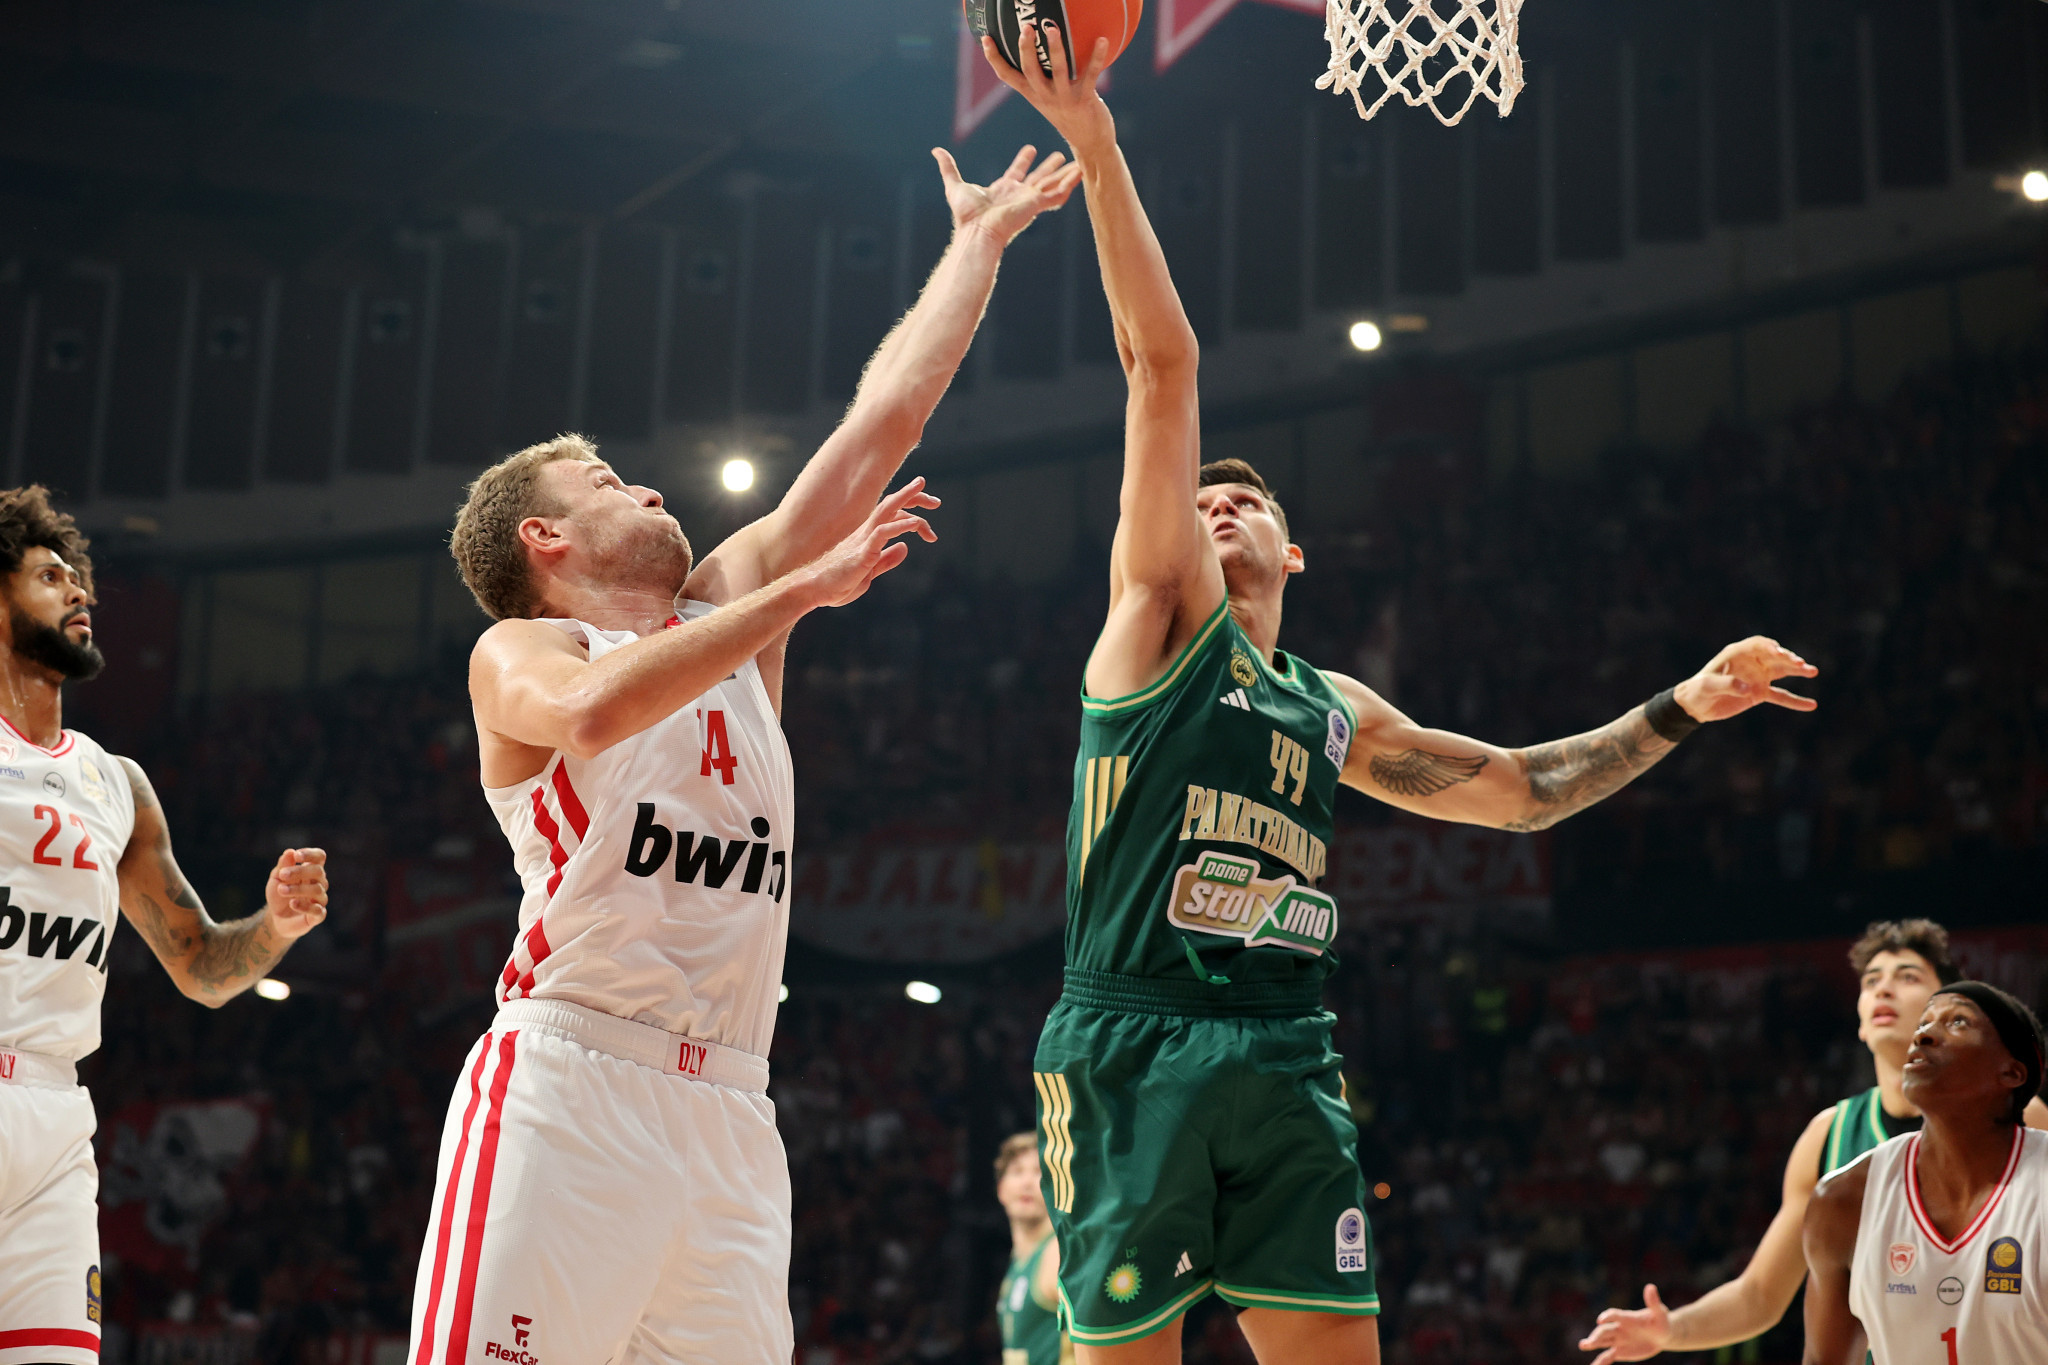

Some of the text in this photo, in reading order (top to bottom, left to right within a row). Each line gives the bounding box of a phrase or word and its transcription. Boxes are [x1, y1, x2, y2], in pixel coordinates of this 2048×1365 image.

[1269, 729, 1309, 806] 44
[33, 803, 99, 872] 22
[624, 802, 786, 904] bwin
[1203, 860, 1249, 883] pame
[678, 1040, 709, 1077] OLY
[1125, 1246, 1138, 1259] bp
[1340, 1255, 1364, 1269] GBL
[1987, 1278, 2020, 1292] GBL
